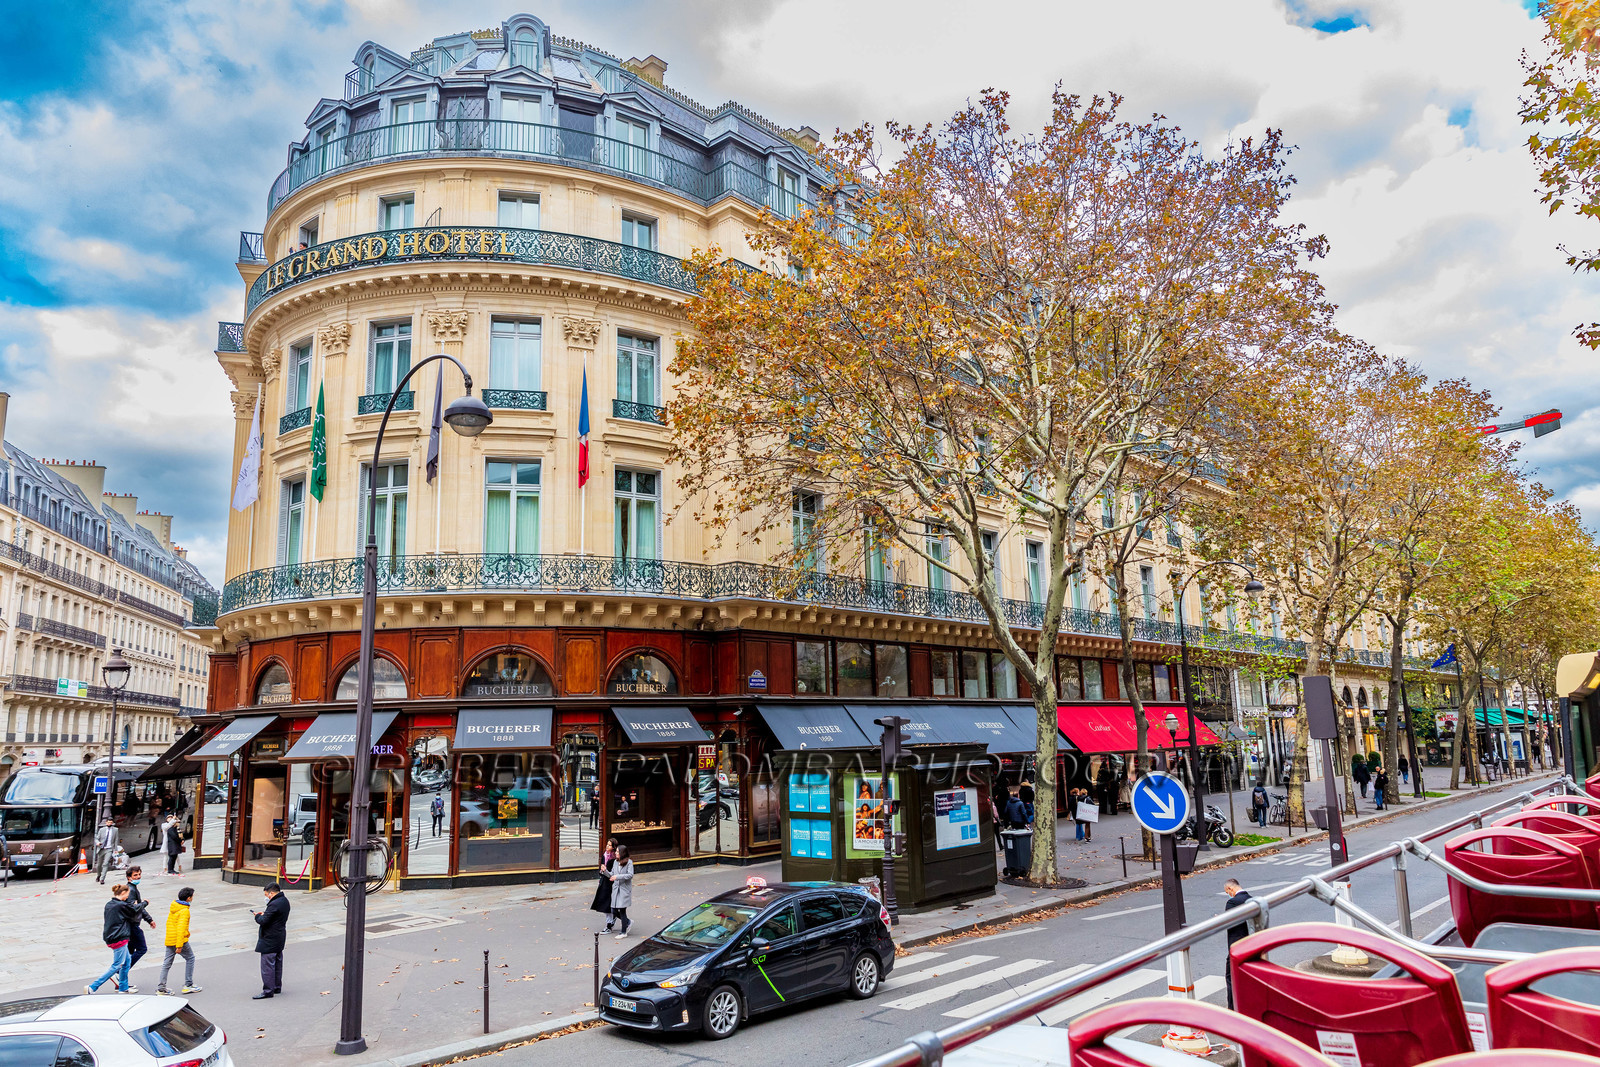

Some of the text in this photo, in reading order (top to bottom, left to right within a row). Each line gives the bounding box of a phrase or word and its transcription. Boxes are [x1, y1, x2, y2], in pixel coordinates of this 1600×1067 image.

[266, 232, 514, 291] LE GRAND HOTEL
[477, 685, 539, 695] BUCHERER
[616, 683, 667, 693] BUCHERER
[466, 724, 541, 734] BUCHERER
[630, 721, 692, 730] BUCHERER
[797, 725, 842, 735] BUCHERER
[322, 744, 343, 752] 1888
